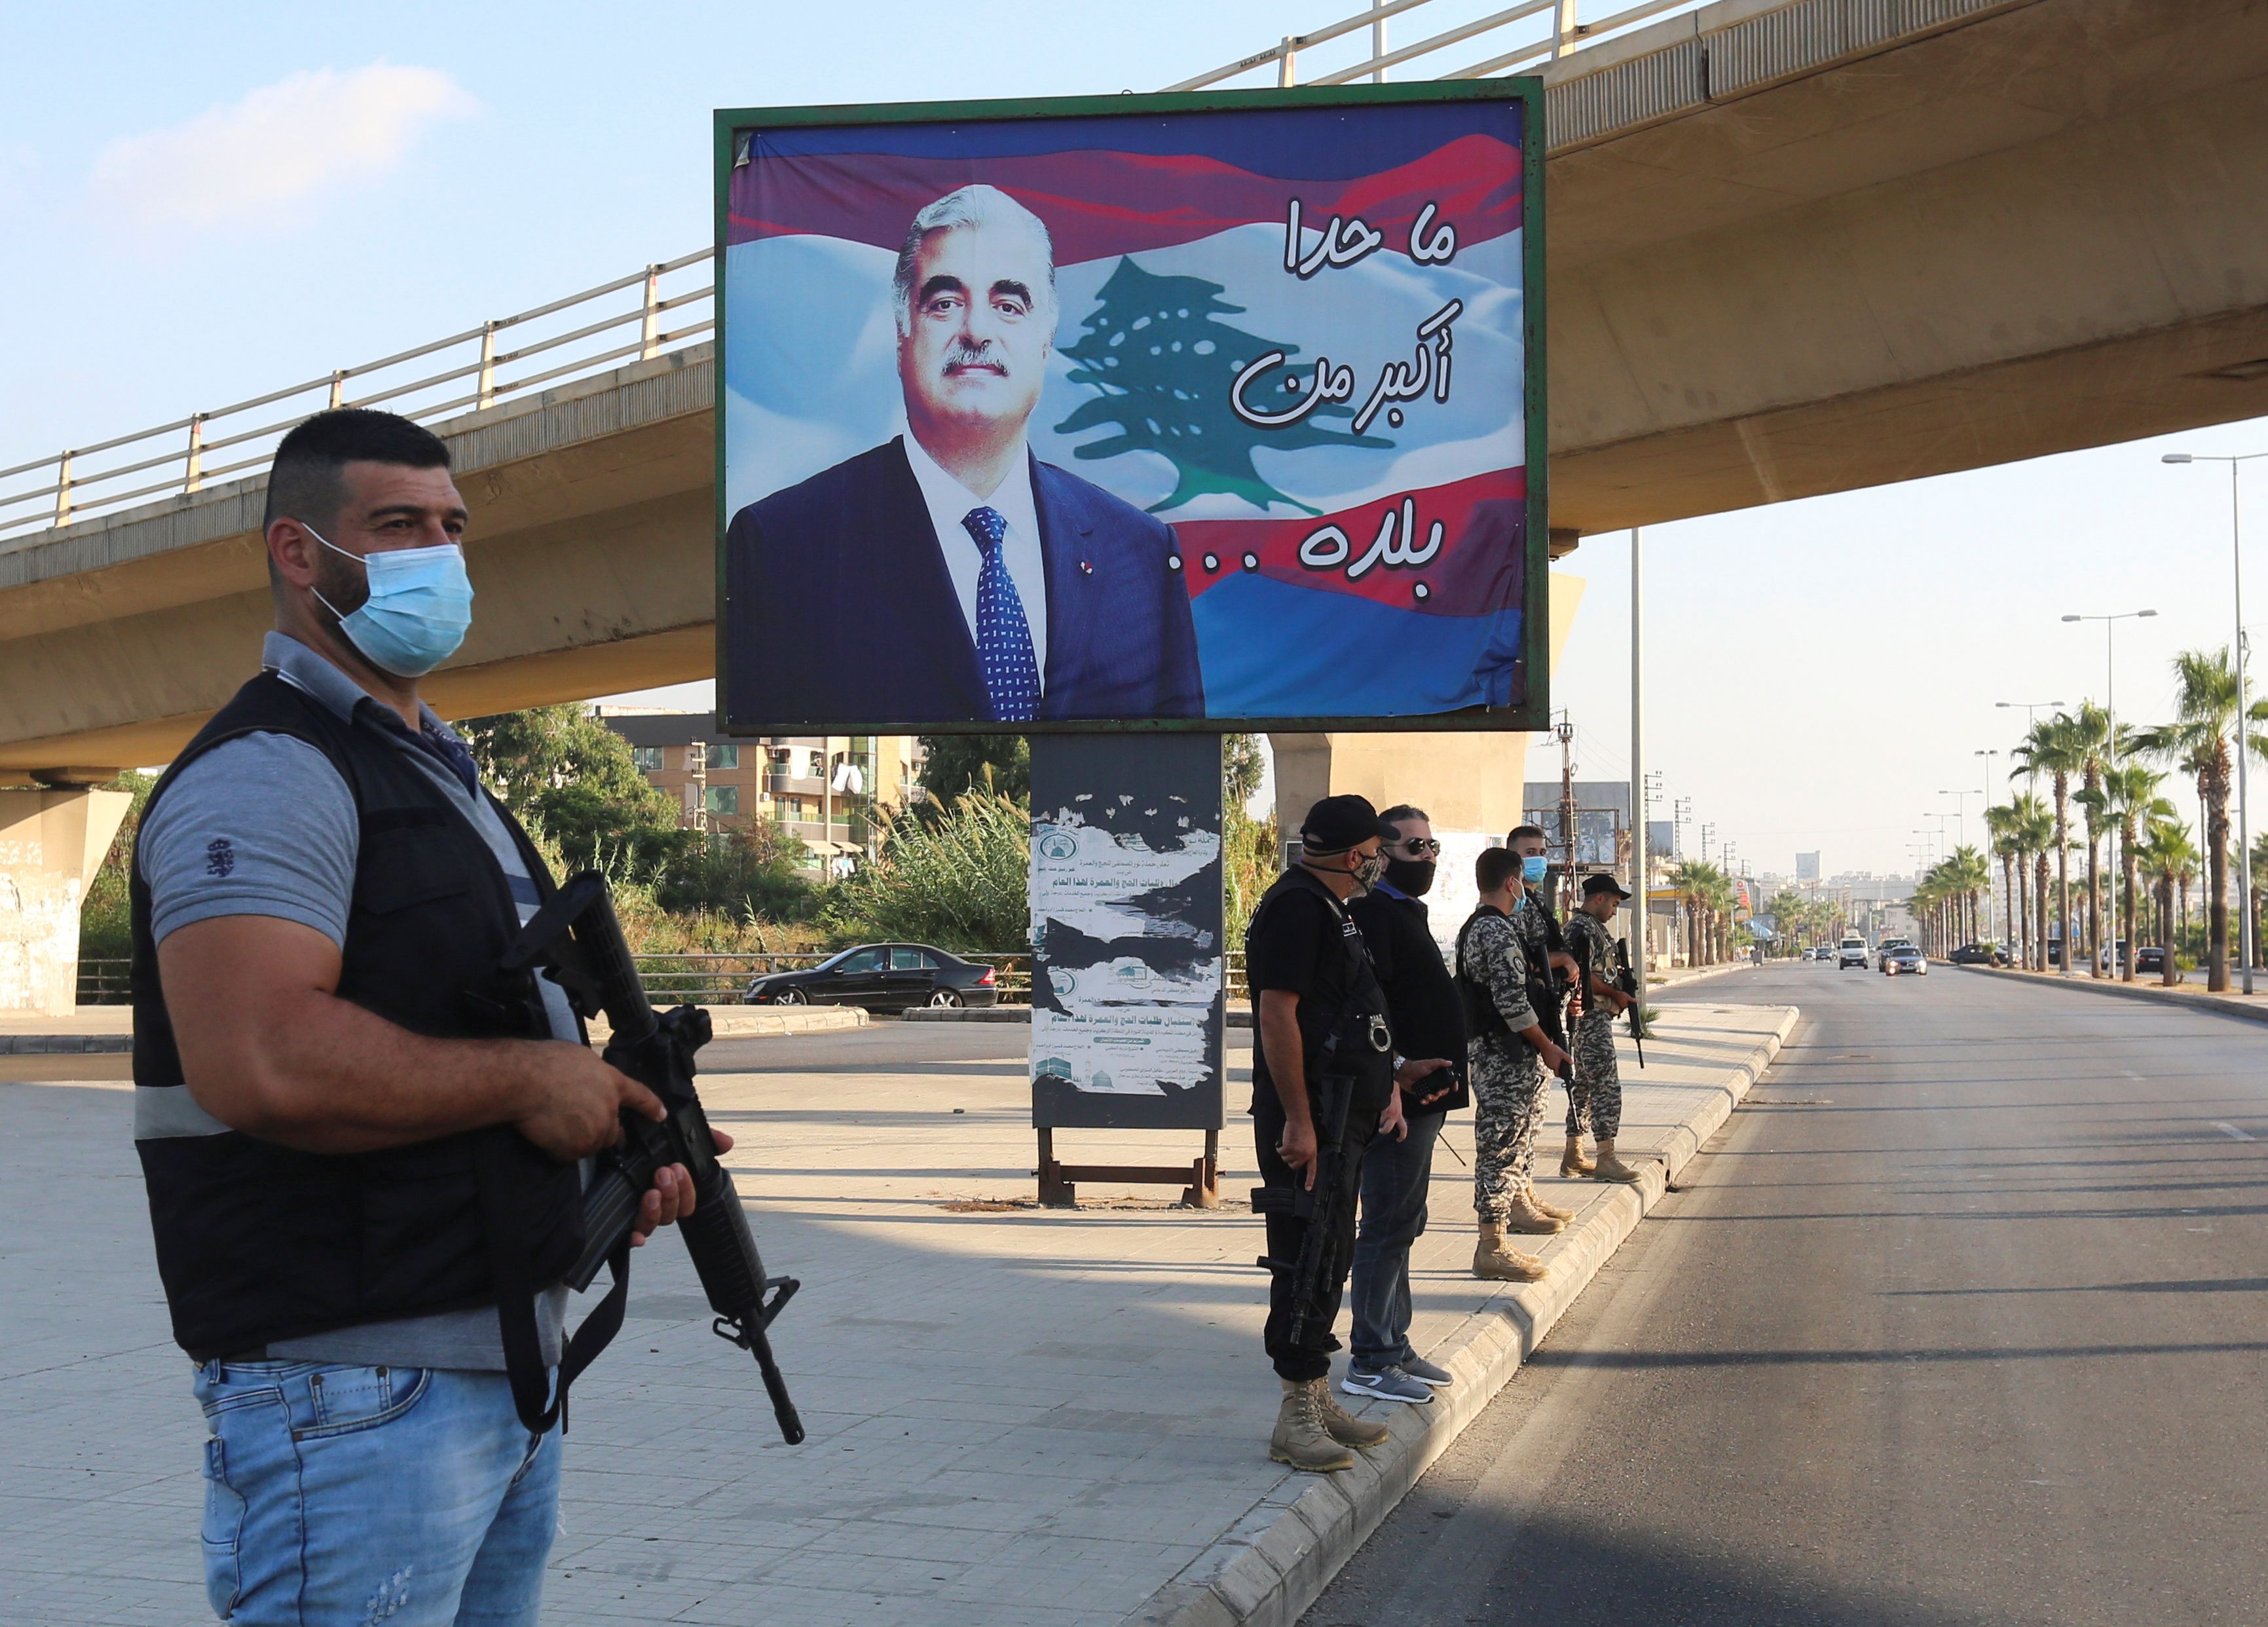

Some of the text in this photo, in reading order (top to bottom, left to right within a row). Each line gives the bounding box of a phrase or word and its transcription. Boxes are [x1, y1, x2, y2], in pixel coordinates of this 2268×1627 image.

[1284, 198, 1457, 279] ما حدا
[1230, 299, 1463, 435] أكبر من
[1052, 877, 1071, 888] العام
[1090, 878, 1120, 888] والعمرة
[1121, 878, 1137, 889] الحج
[1088, 1014, 1119, 1026] والعمرة
[1121, 1015, 1136, 1026] الحج
[1138, 1015, 1162, 1027] طلبات
